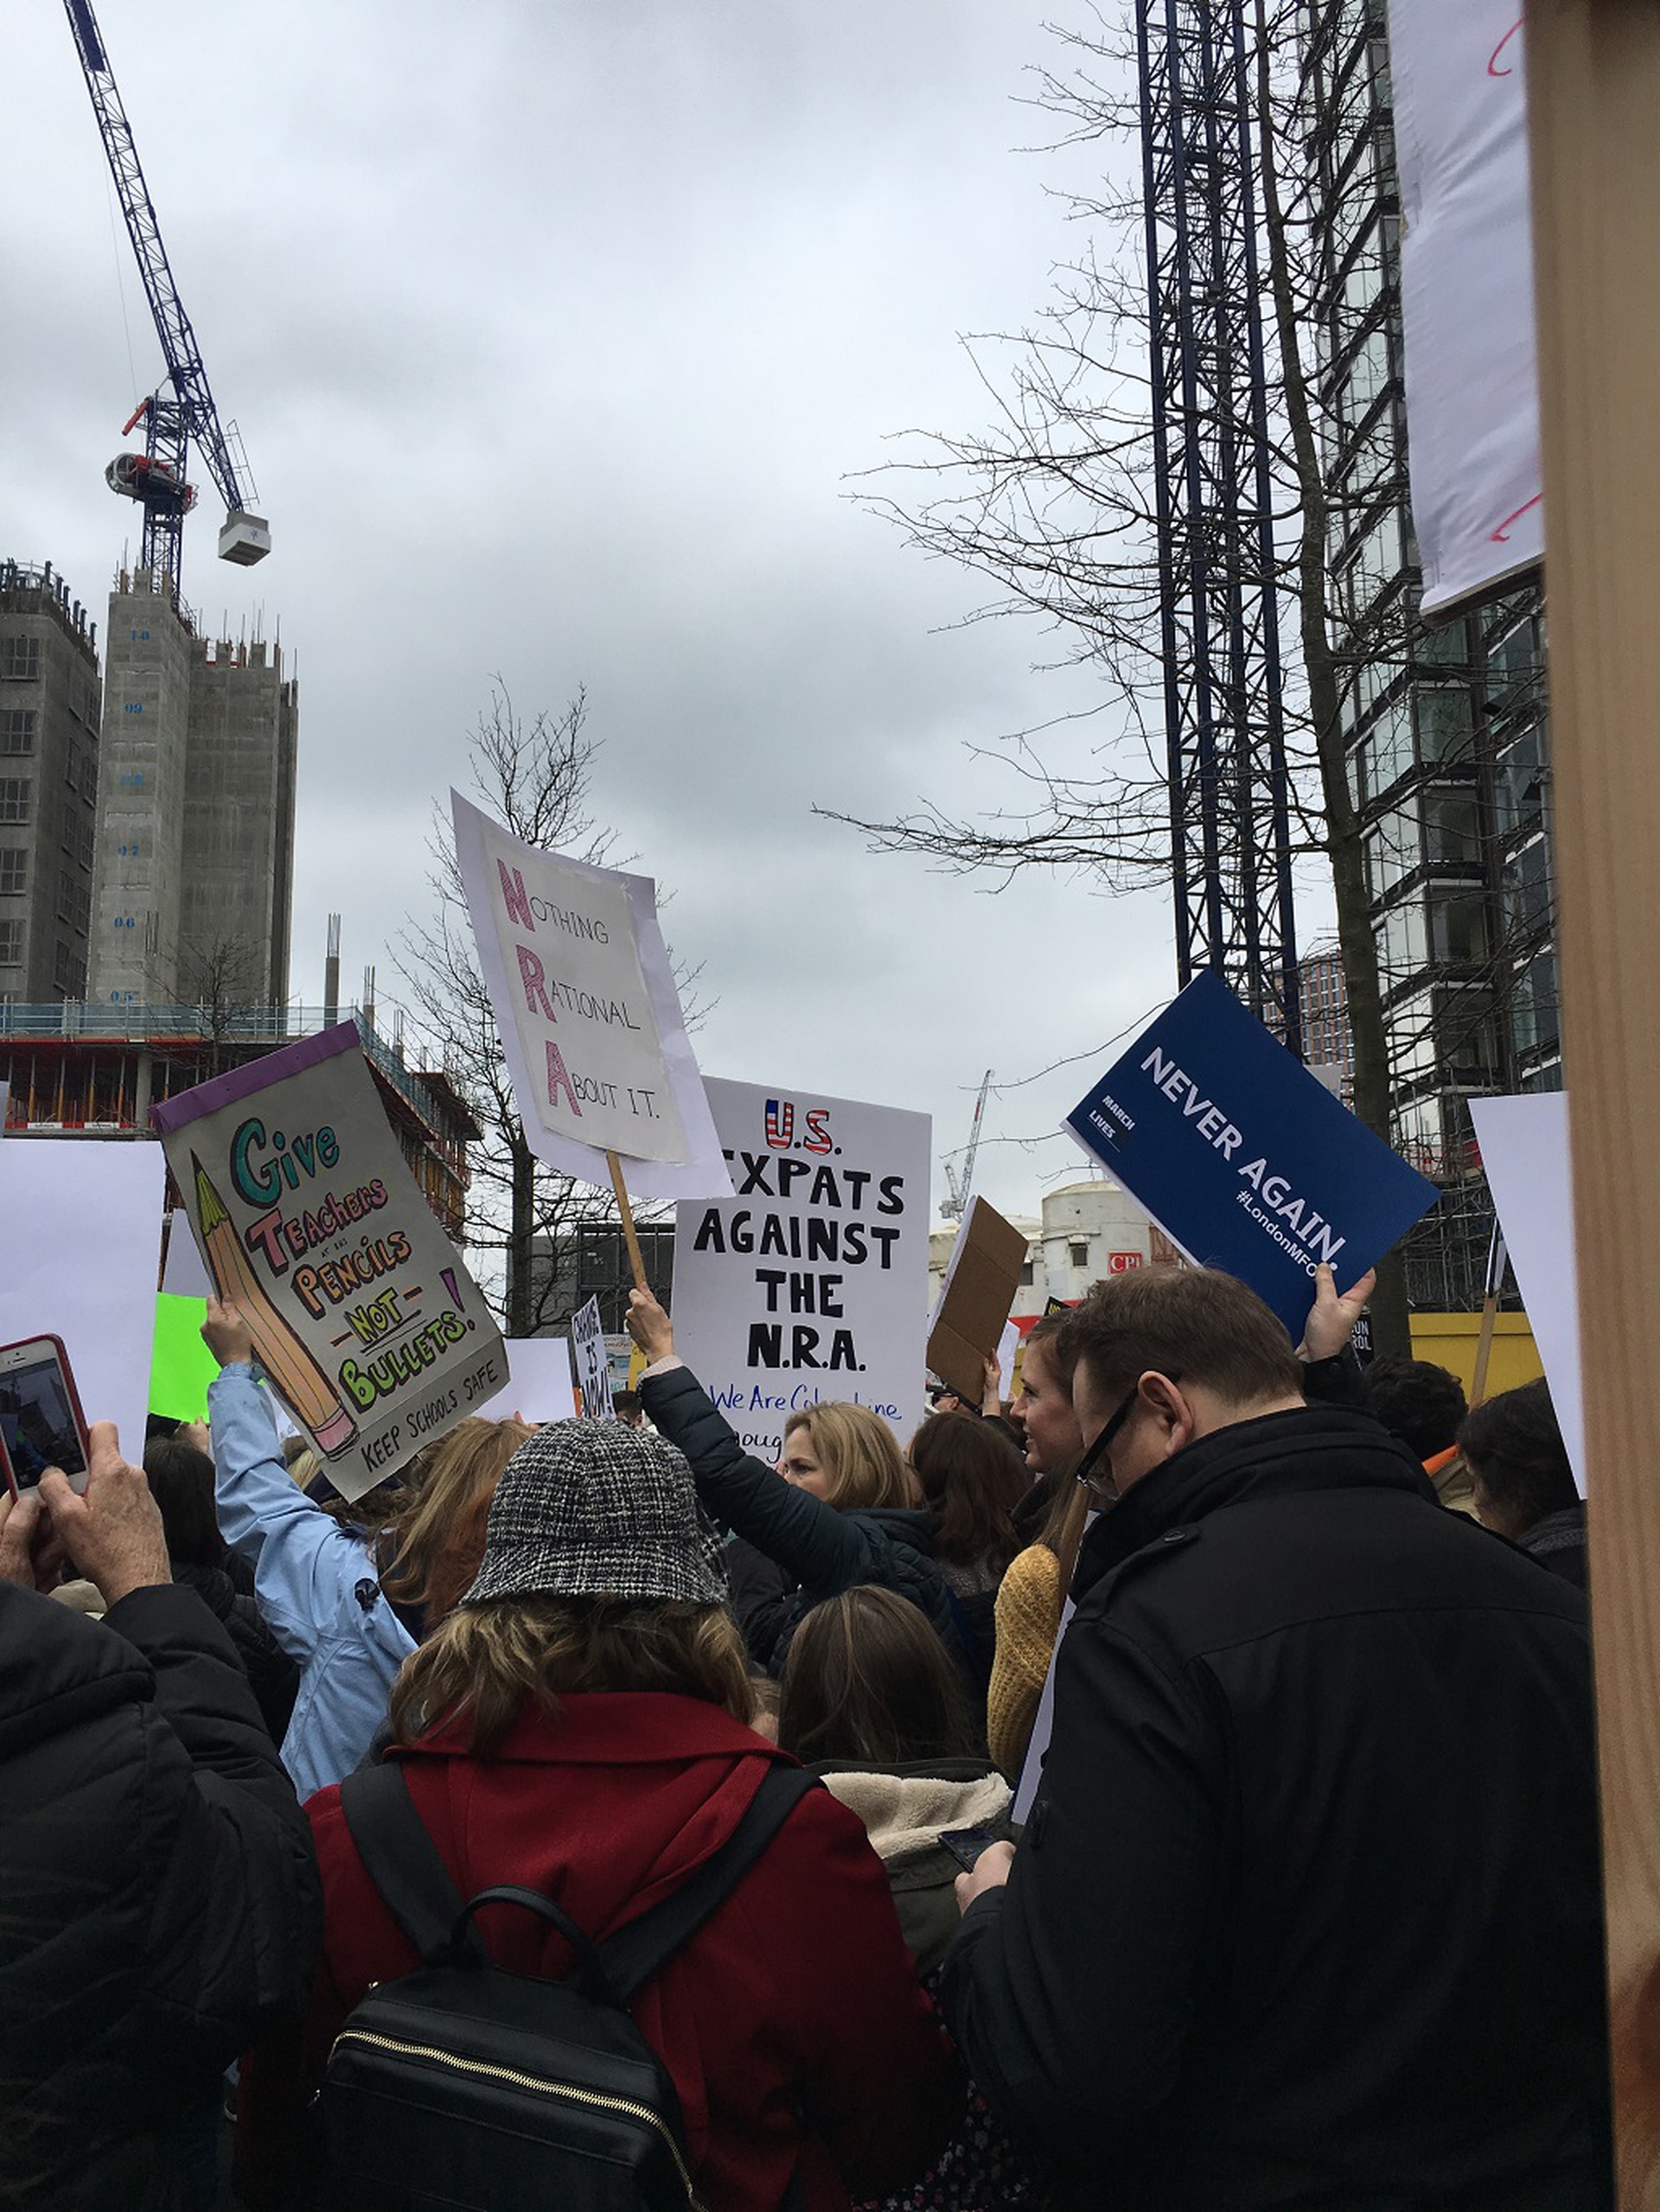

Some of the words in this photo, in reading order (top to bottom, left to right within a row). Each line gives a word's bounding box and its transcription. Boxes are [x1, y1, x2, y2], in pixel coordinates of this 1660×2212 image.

[124, 702, 144, 714] 09
[113, 916, 136, 929] 06
[497, 857, 610, 944] NOTHING
[109, 991, 134, 1003] 05
[516, 945, 641, 1030] RATIONAL
[546, 1040, 619, 1117] ABOUT
[629, 1089, 661, 1119] IT.
[764, 1099, 842, 1155] U.S.
[1089, 1109, 1117, 1138] LIVES
[1101, 1094, 1136, 1131] MARCH
[1140, 1046, 1243, 1161] NEVER
[1237, 1157, 1347, 1272] AGAIN.
[693, 1208, 901, 1270] AGAINST
[756, 1268, 844, 1318] THE
[747, 1323, 866, 1373] N.R.A.
[1351, 1321, 1370, 1336] UN
[360, 1425, 400, 1473] KEEP
[405, 1389, 458, 1438] SCHOOLS
[463, 1359, 499, 1401] SAFE
[709, 1383, 744, 1410] We
[749, 1385, 786, 1412] Are
